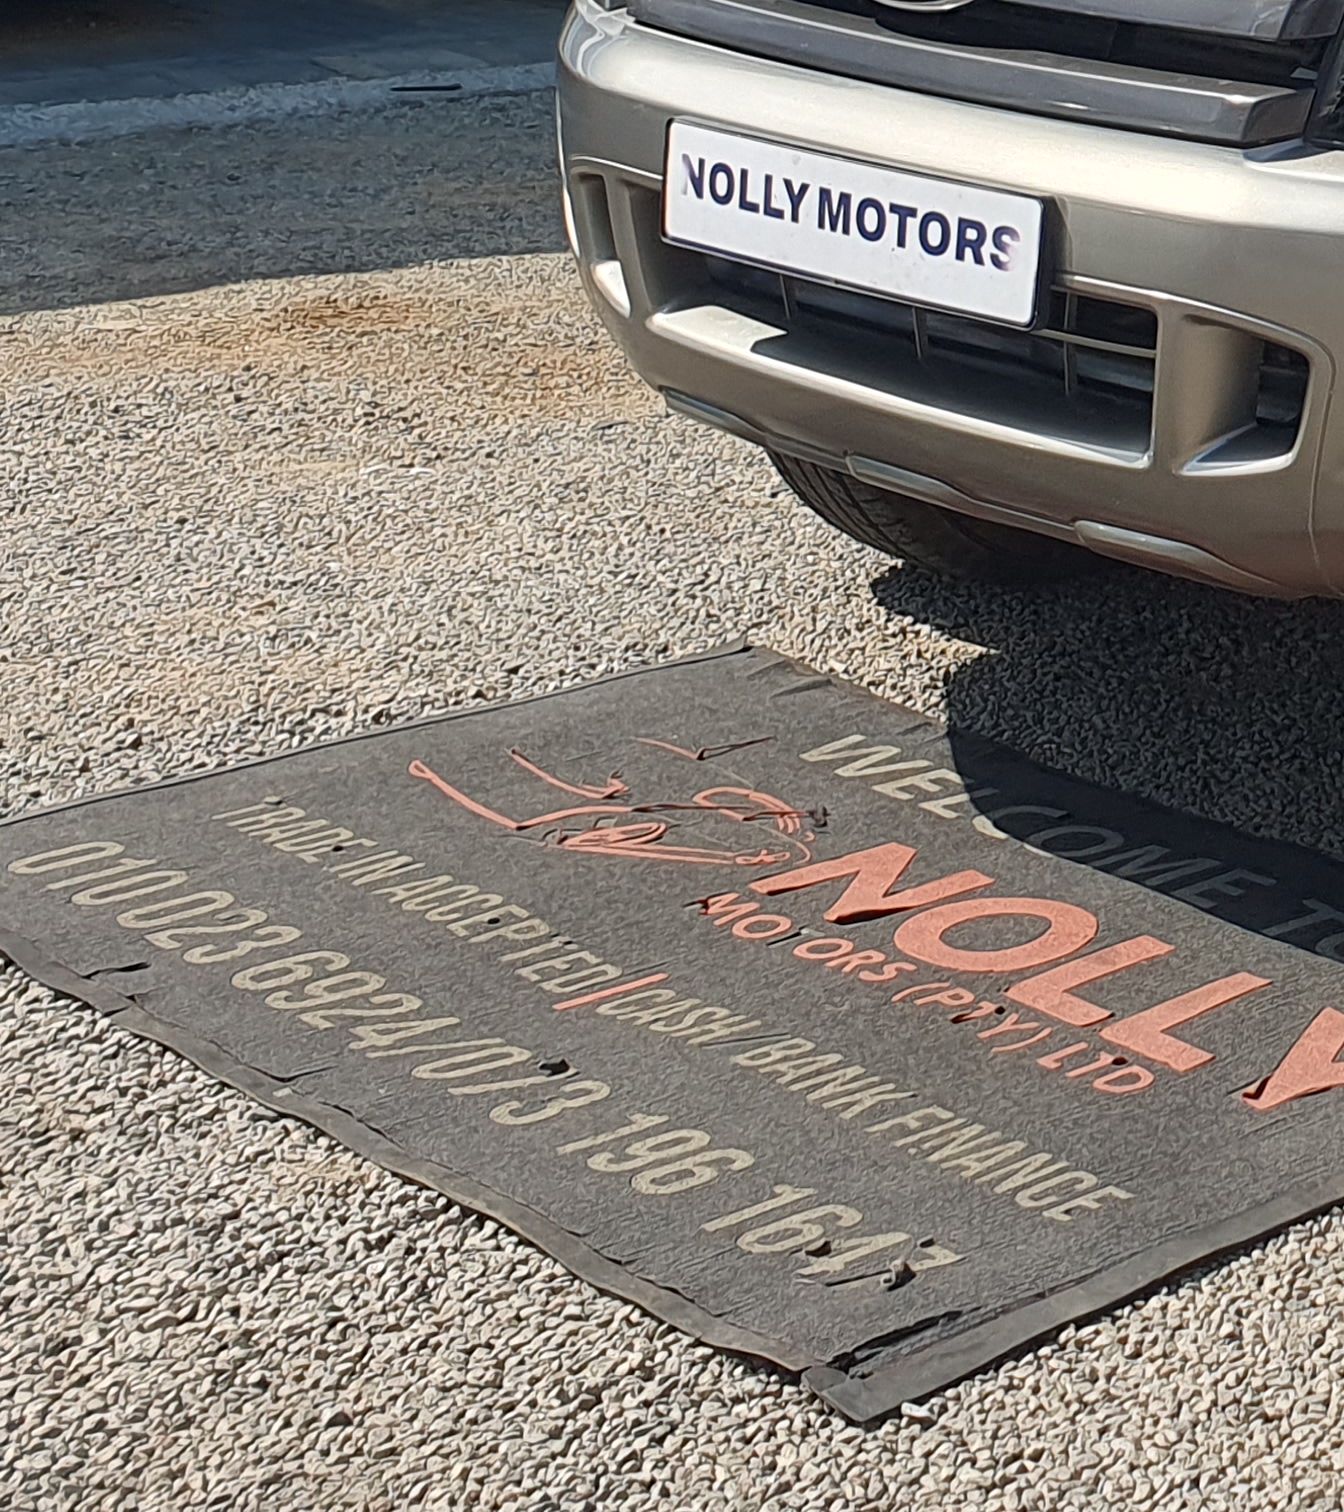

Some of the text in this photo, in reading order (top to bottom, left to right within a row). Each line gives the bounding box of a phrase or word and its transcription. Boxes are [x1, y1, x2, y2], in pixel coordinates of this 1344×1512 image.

[681, 152, 1022, 273] NOLLY MOTORS
[800, 734, 1279, 910] WELCOME
[7, 840, 190, 907] 010
[115, 889, 302, 965] 023
[556, 1112, 755, 1196] 196
[211, 795, 380, 864] TRADE
[327, 850, 426, 887] IN
[863, 1104, 1137, 1222] FINANCE
[890, 982, 1053, 1054] (PTY)
[1036, 1041, 1156, 1094] LTD
